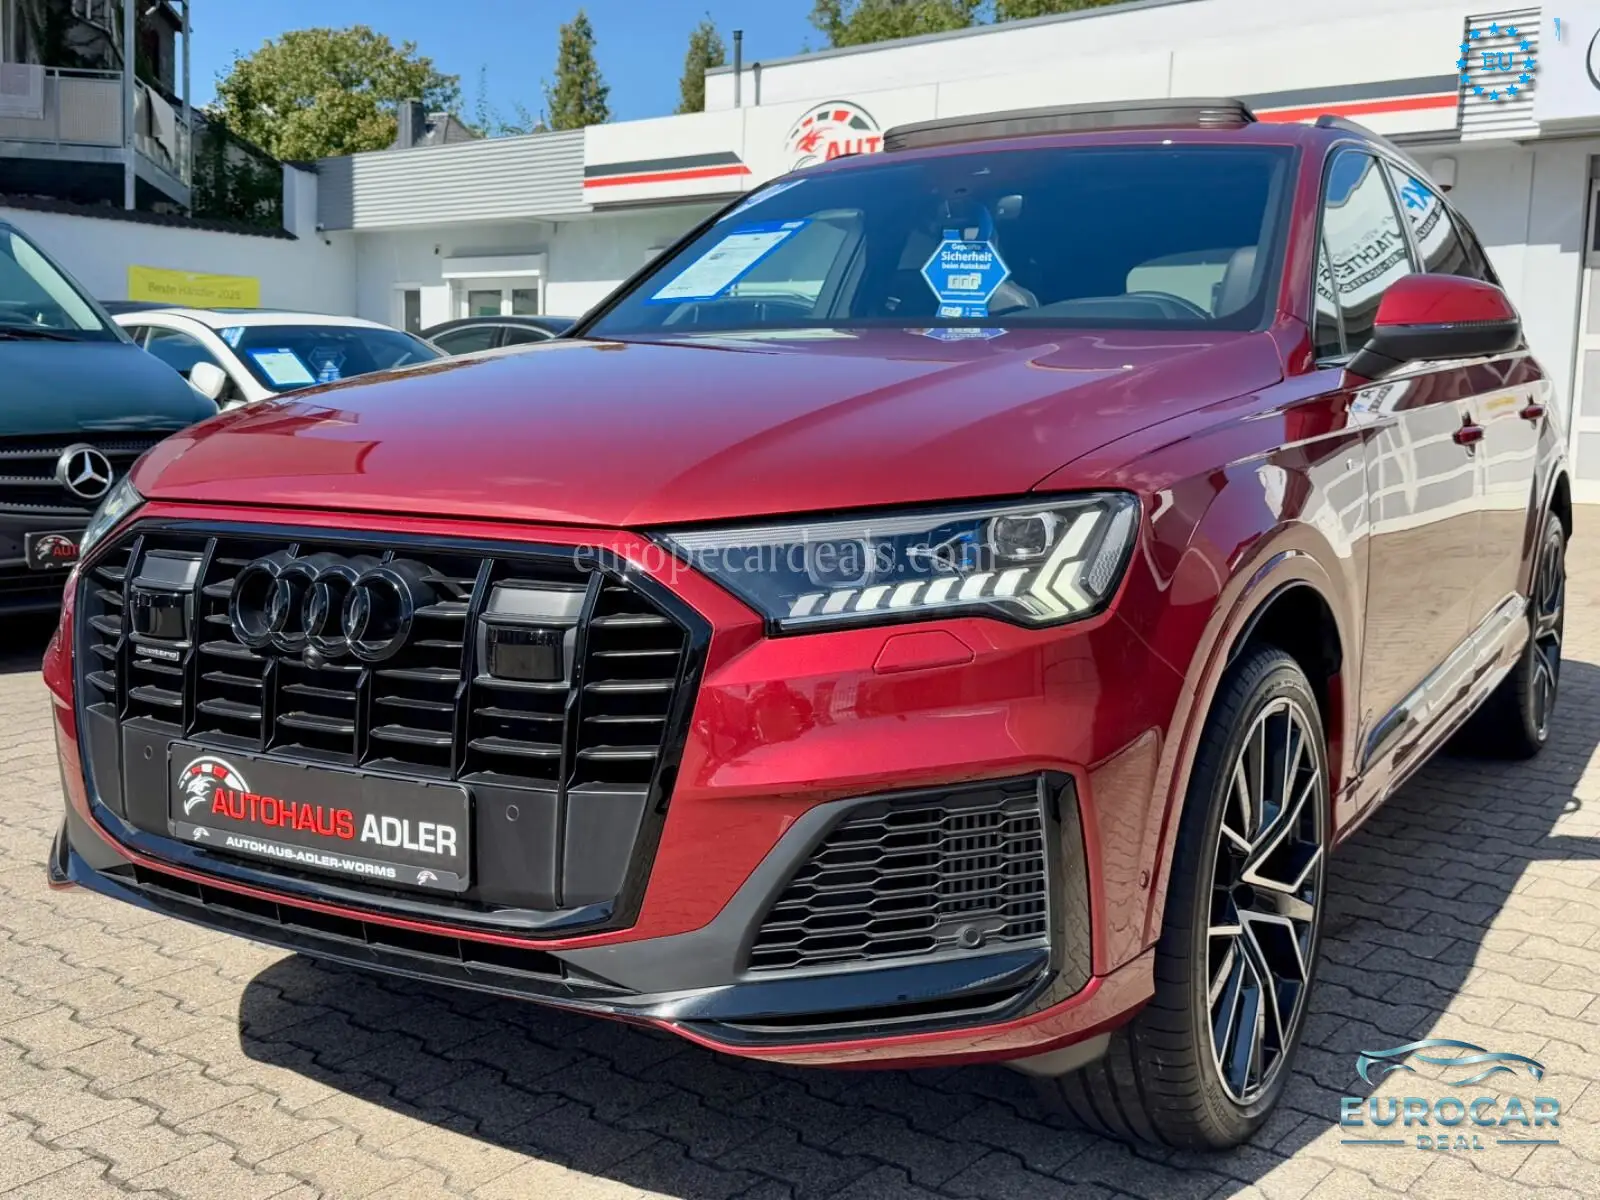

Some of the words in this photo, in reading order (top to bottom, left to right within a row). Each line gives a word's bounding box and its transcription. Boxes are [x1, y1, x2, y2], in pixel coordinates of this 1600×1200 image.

[941, 251, 993, 262] Sicherheit
[942, 262, 959, 270] beim
[960, 262, 991, 270] Autokauf
[211, 787, 355, 840] AUTOHAUS
[360, 813, 457, 856] ADLER
[225, 835, 397, 878] AUTOHAUS-ADLER-WORMS
